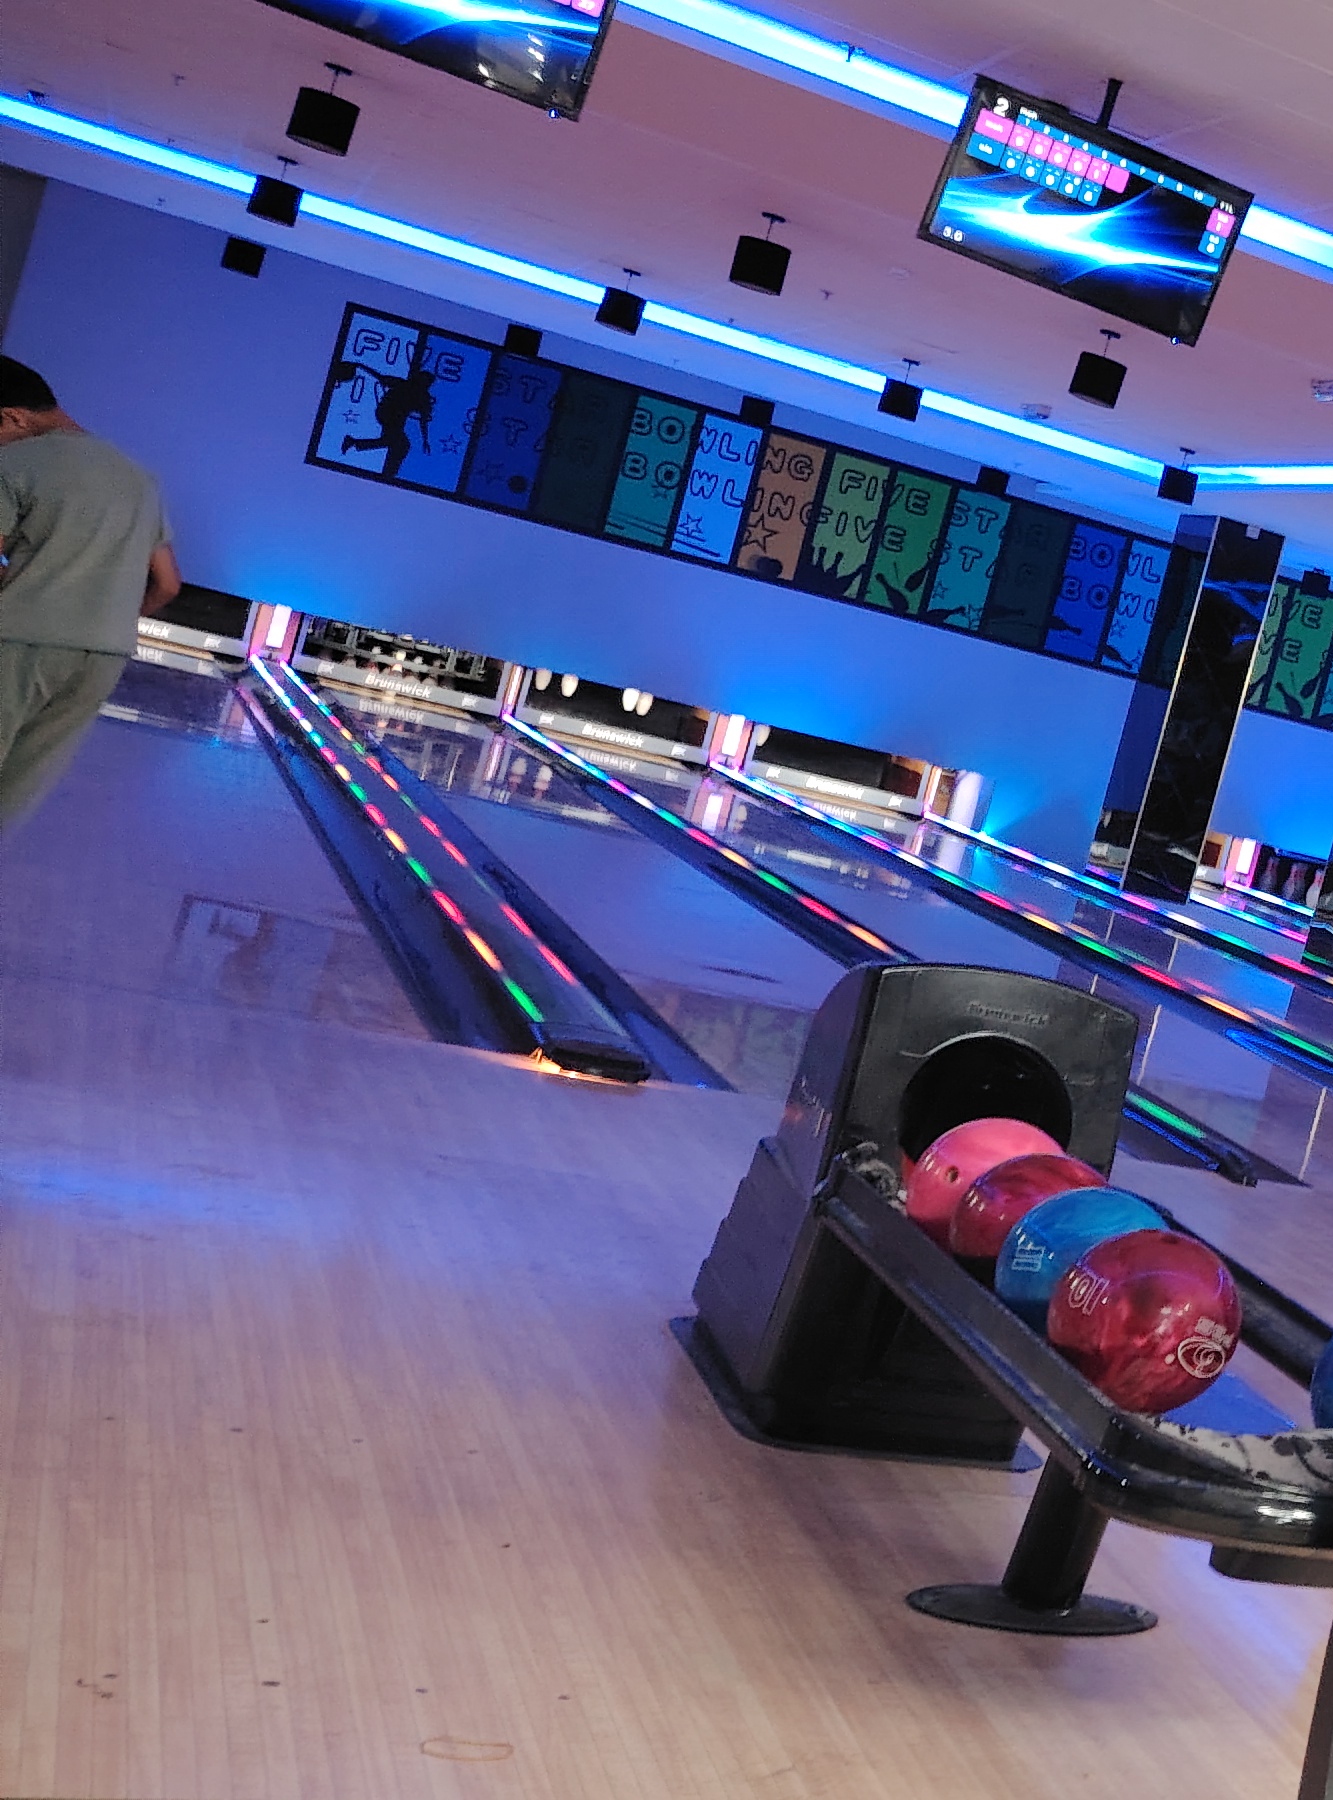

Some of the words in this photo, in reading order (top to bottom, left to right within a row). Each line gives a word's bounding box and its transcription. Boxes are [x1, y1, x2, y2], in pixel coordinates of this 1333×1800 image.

[353, 328, 465, 383] FIVE
[839, 469, 931, 516] FIVE
[364, 673, 432, 699] Brunswick
